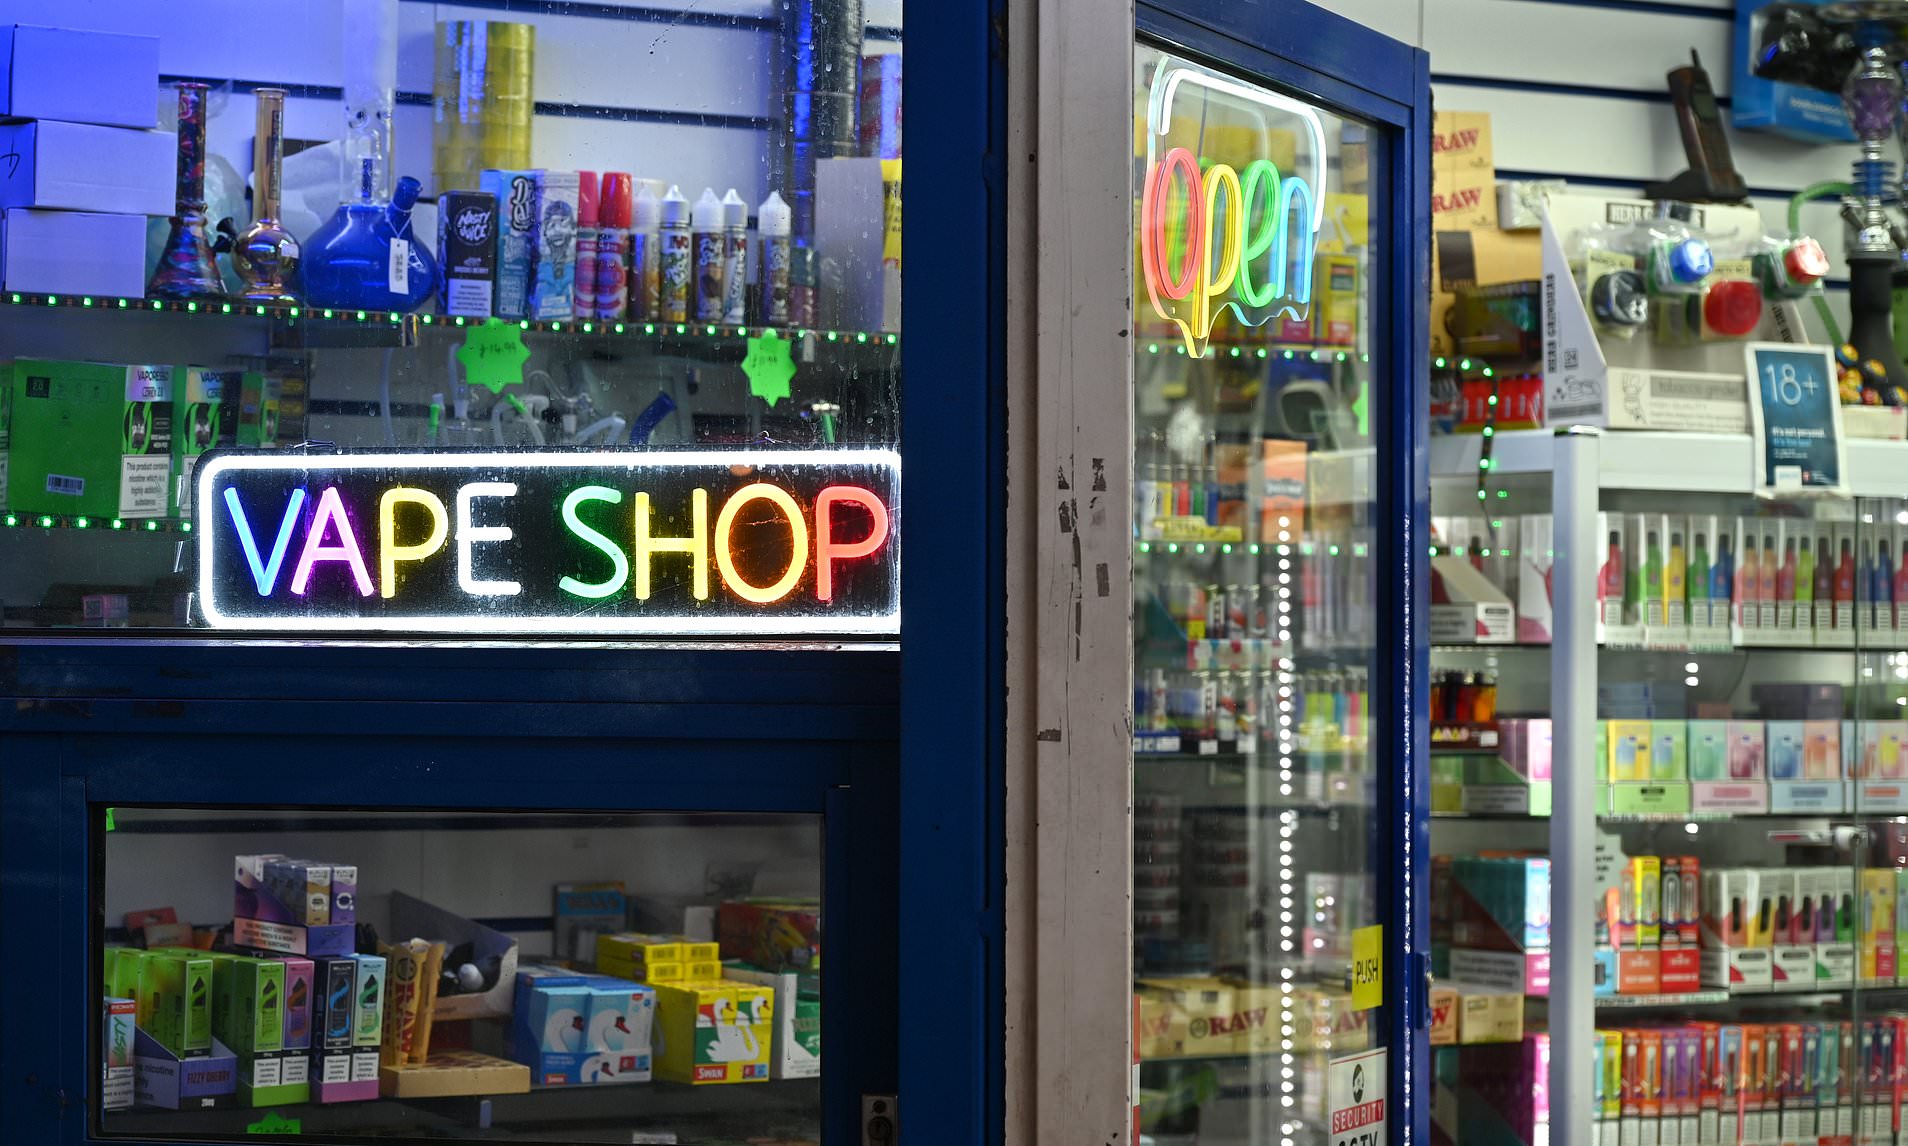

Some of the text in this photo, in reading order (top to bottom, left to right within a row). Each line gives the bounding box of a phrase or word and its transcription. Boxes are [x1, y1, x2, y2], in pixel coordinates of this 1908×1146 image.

[1433, 128, 1479, 153] RAW
[1432, 188, 1481, 213] RAW
[457, 211, 491, 227] NASTY
[459, 225, 488, 241] JUICE
[1765, 362, 1819, 405] 18+
[224, 482, 889, 603] VAPE SHOP
[1356, 958, 1379, 984] PUSH
[1209, 1008, 1268, 1036] RAW
[698, 1067, 724, 1079] SWAN
[1334, 1100, 1384, 1132] SECURITY
